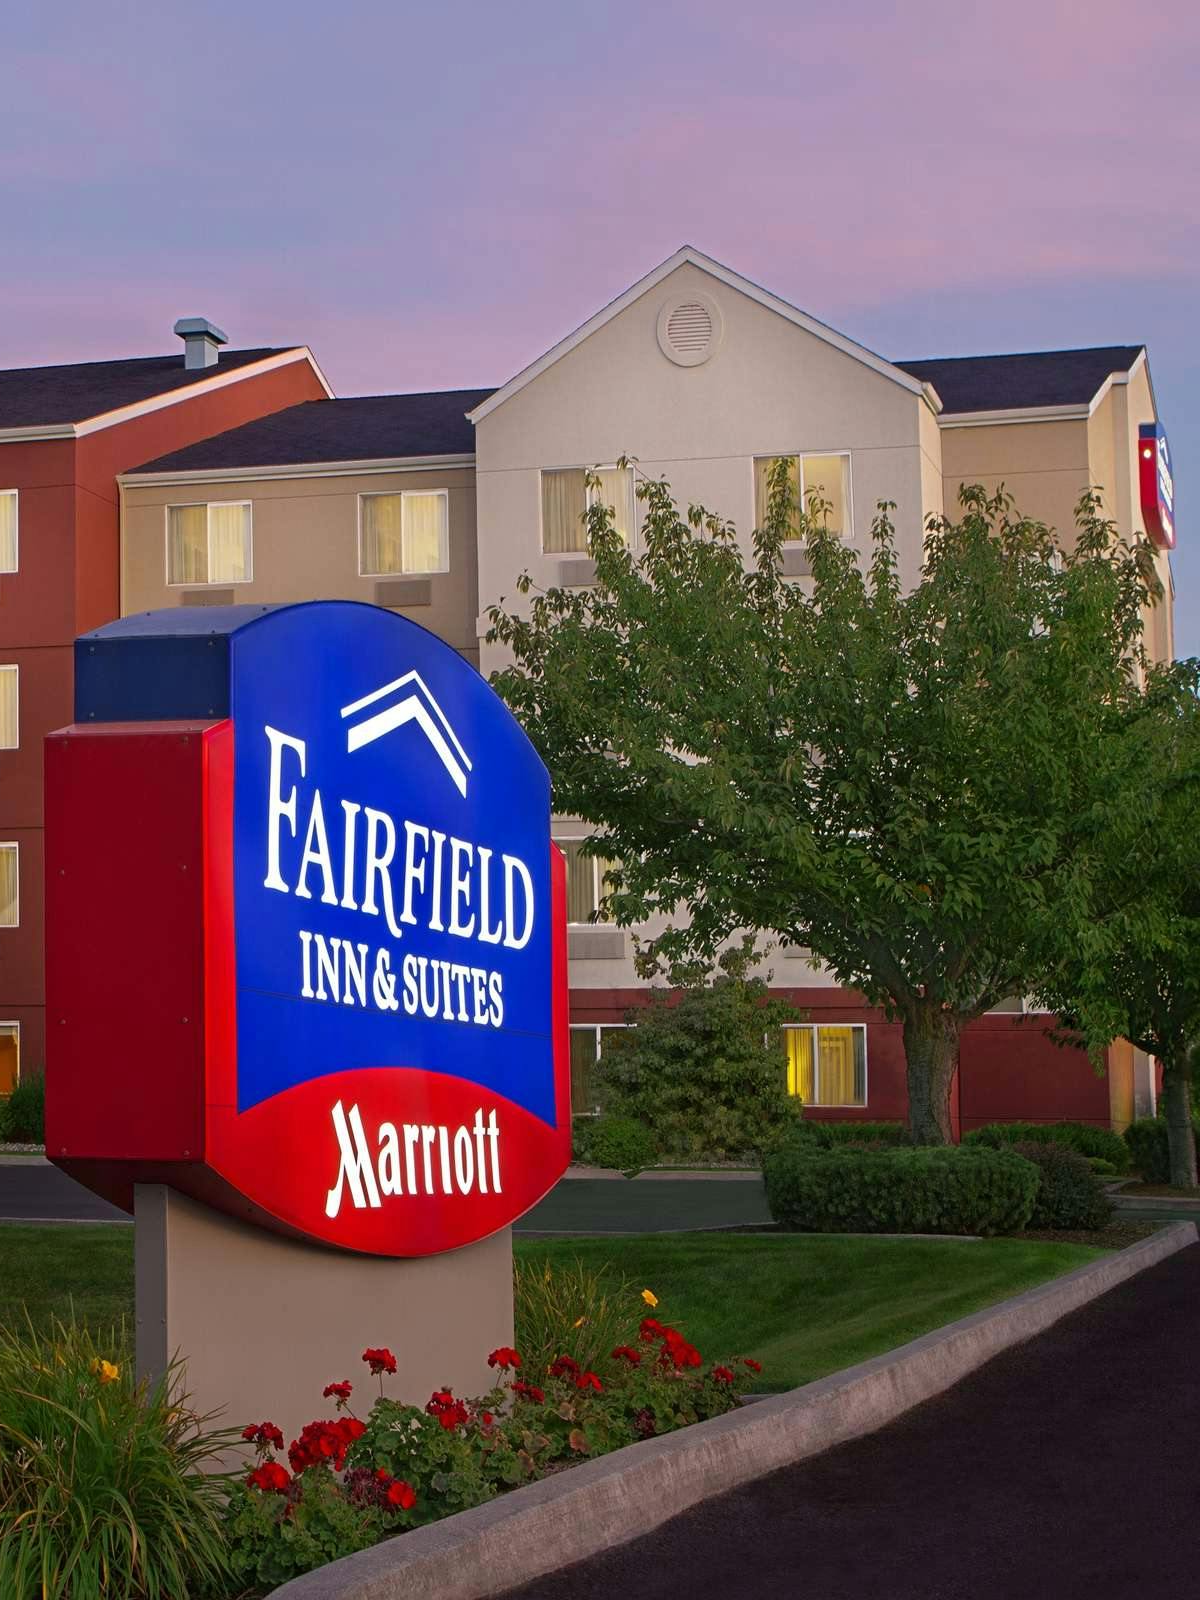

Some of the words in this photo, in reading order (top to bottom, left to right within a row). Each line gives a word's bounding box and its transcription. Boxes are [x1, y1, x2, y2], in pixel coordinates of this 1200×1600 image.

[263, 725, 536, 950] FAIRFIELD
[299, 930, 369, 1008] INN
[402, 953, 504, 1028] SUITES
[325, 1099, 502, 1219] Marriott
